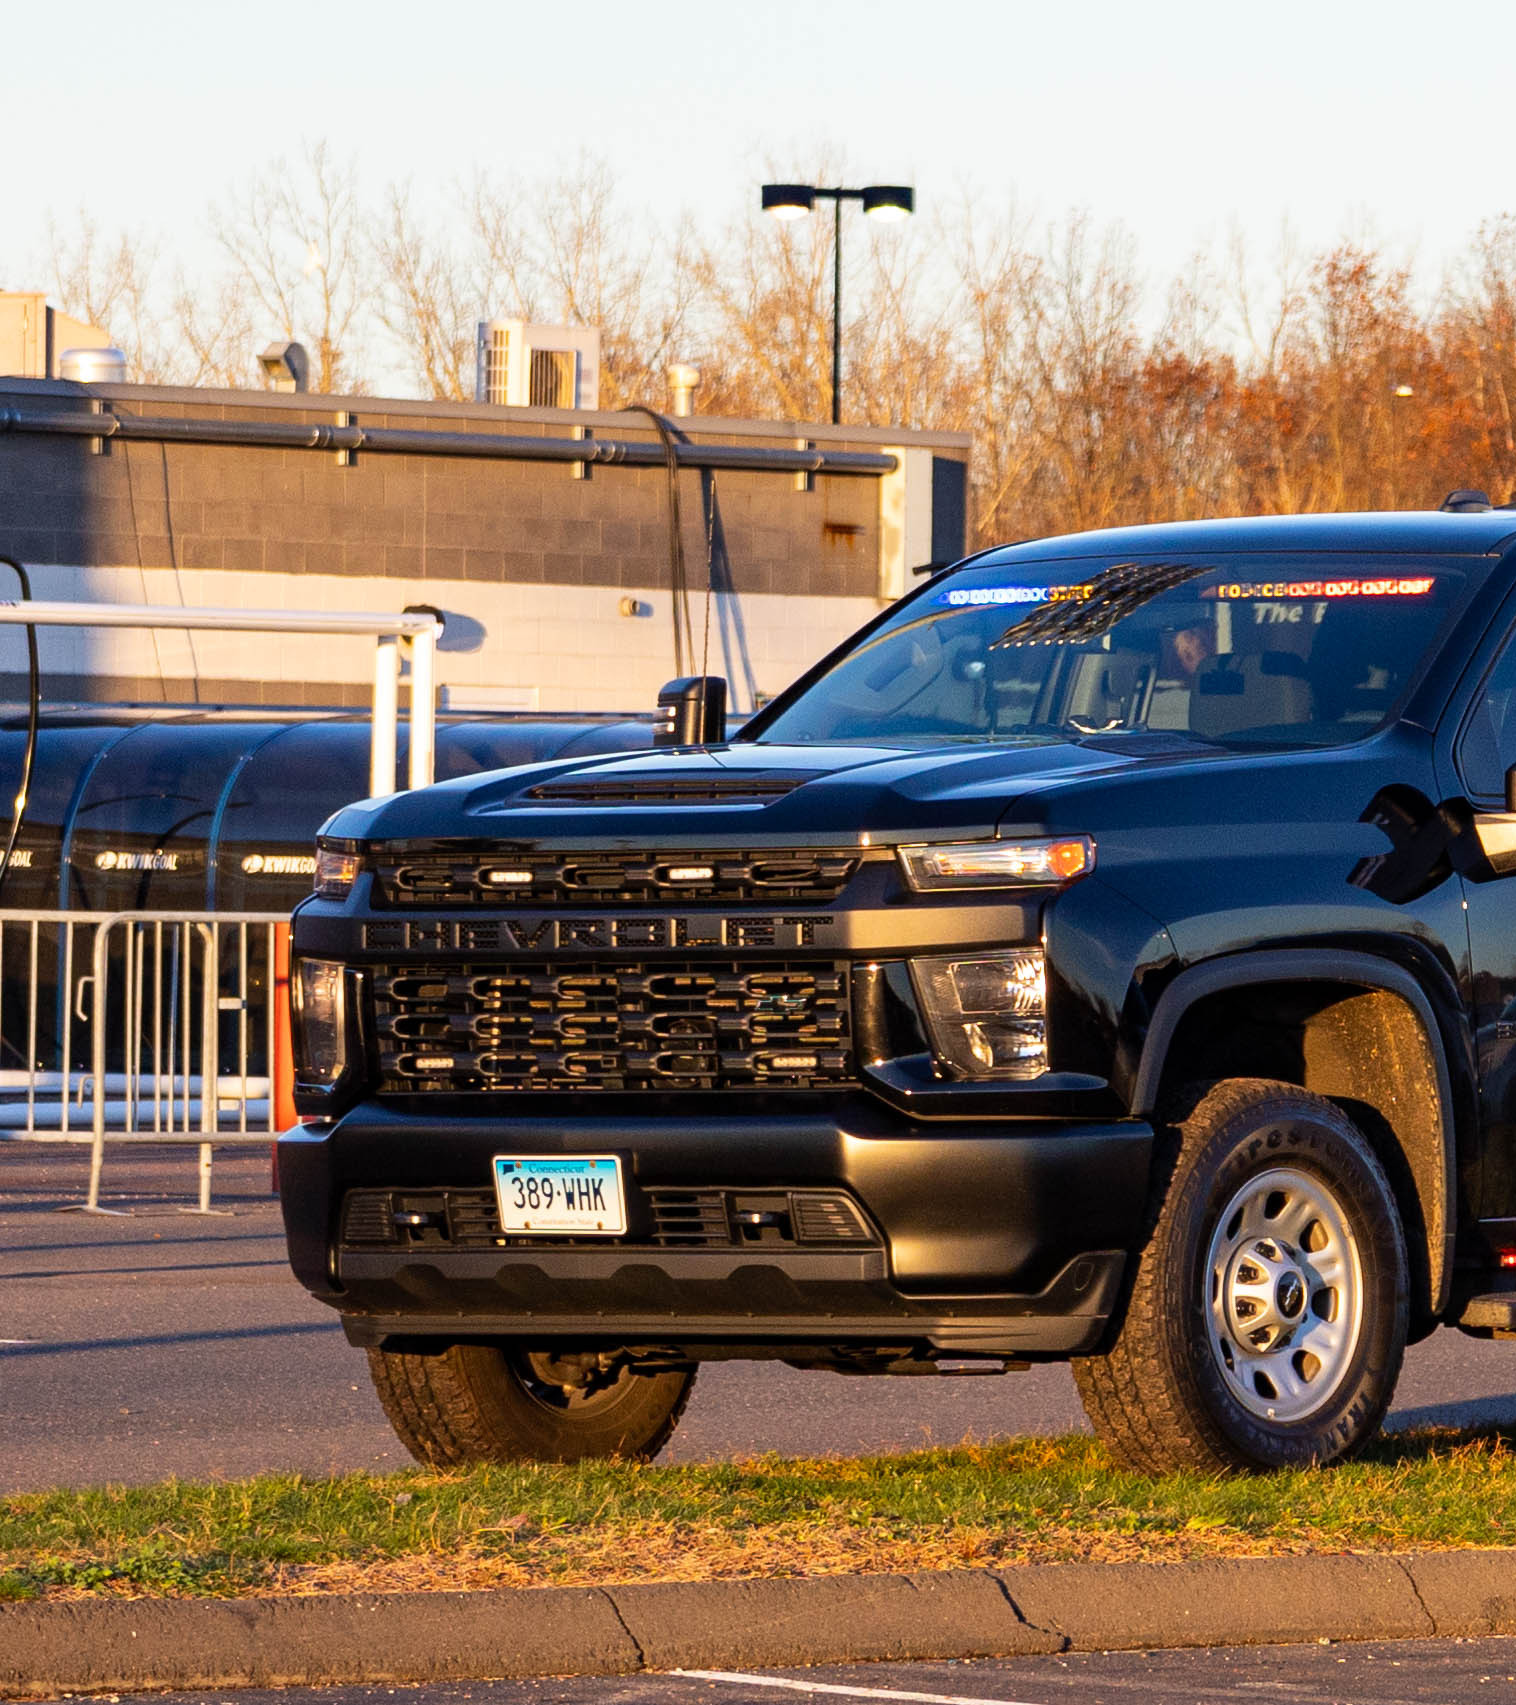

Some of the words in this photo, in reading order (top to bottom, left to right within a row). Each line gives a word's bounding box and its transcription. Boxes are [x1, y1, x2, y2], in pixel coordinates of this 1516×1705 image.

[1254, 602, 1303, 624] The
[263, 855, 318, 874] KWIKGO
[361, 915, 835, 951] CHEVROLET
